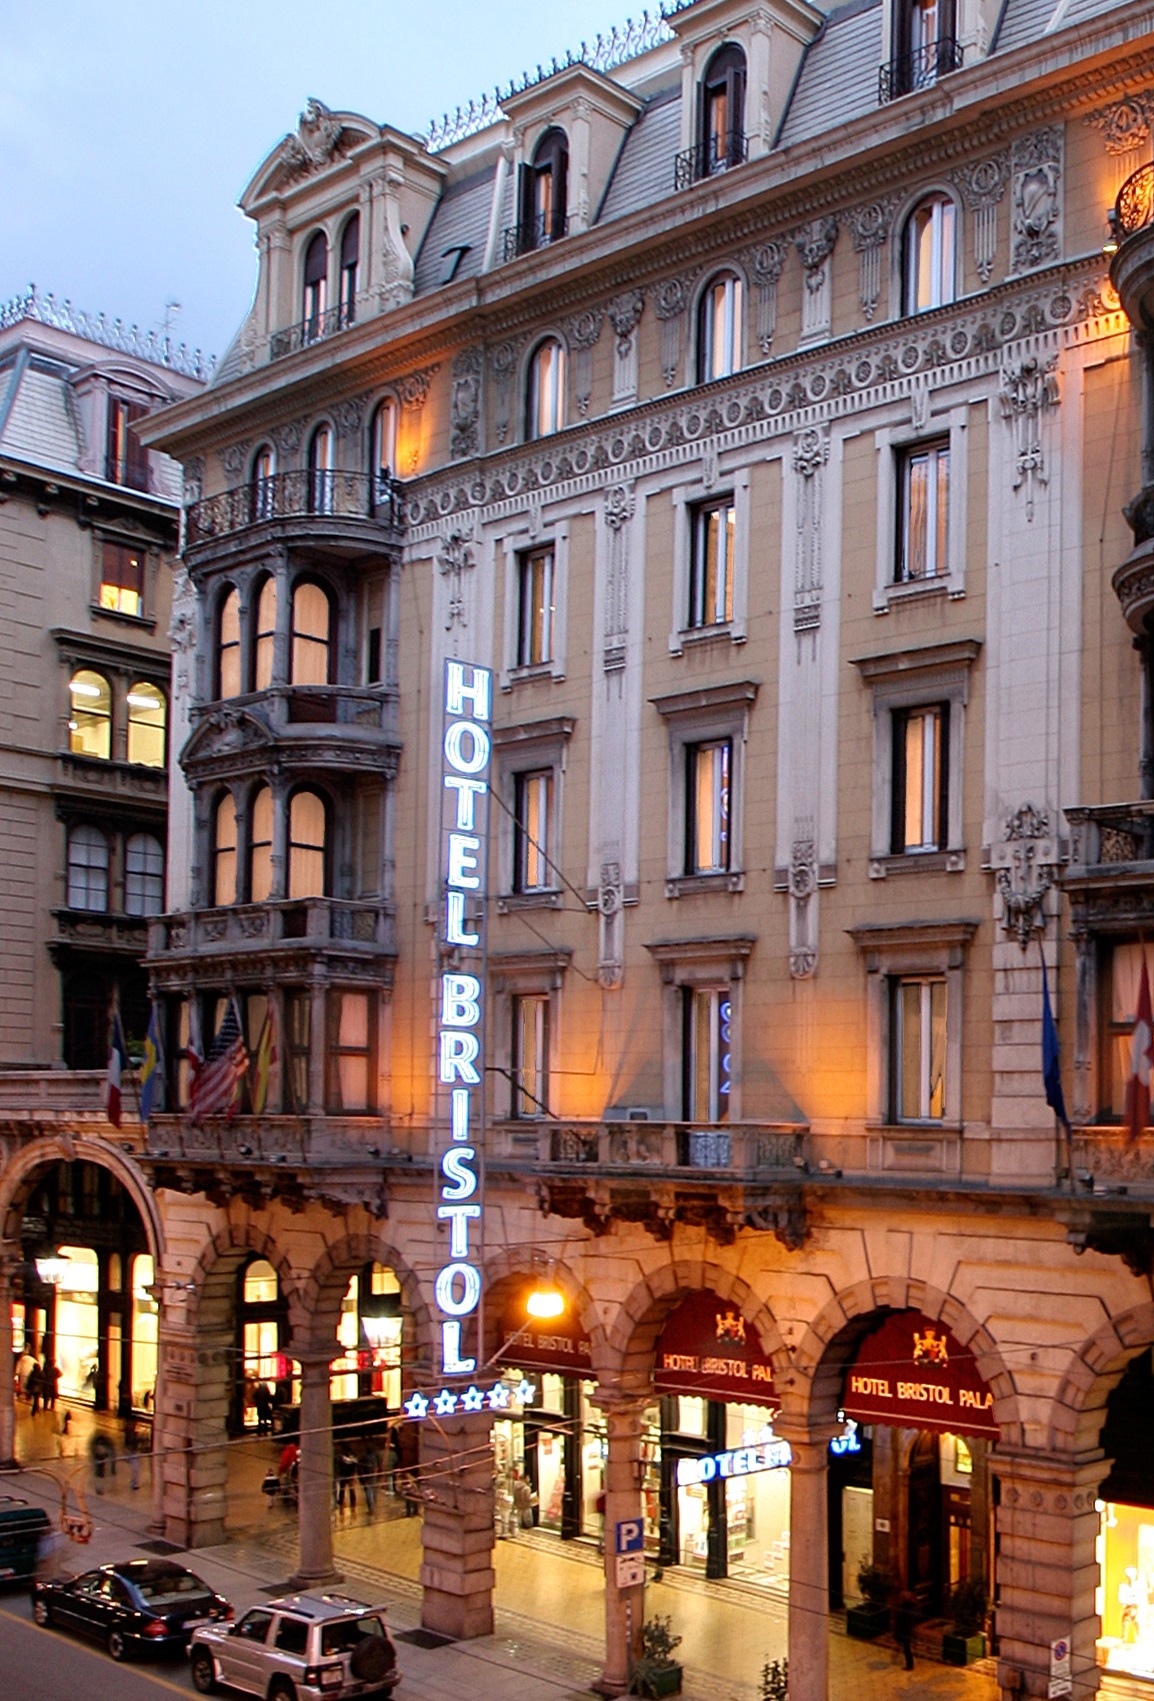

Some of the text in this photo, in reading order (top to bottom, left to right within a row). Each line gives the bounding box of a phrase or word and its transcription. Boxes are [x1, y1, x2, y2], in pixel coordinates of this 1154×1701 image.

[435, 661, 491, 1375] HOTEL BRISTOL
[663, 1353, 698, 1373] HOTEL
[701, 1357, 749, 1379] BRISTOL
[851, 1375, 893, 1398] HOTEL
[896, 1381, 954, 1405] BRISTOL
[620, 1522, 640, 1551] P
